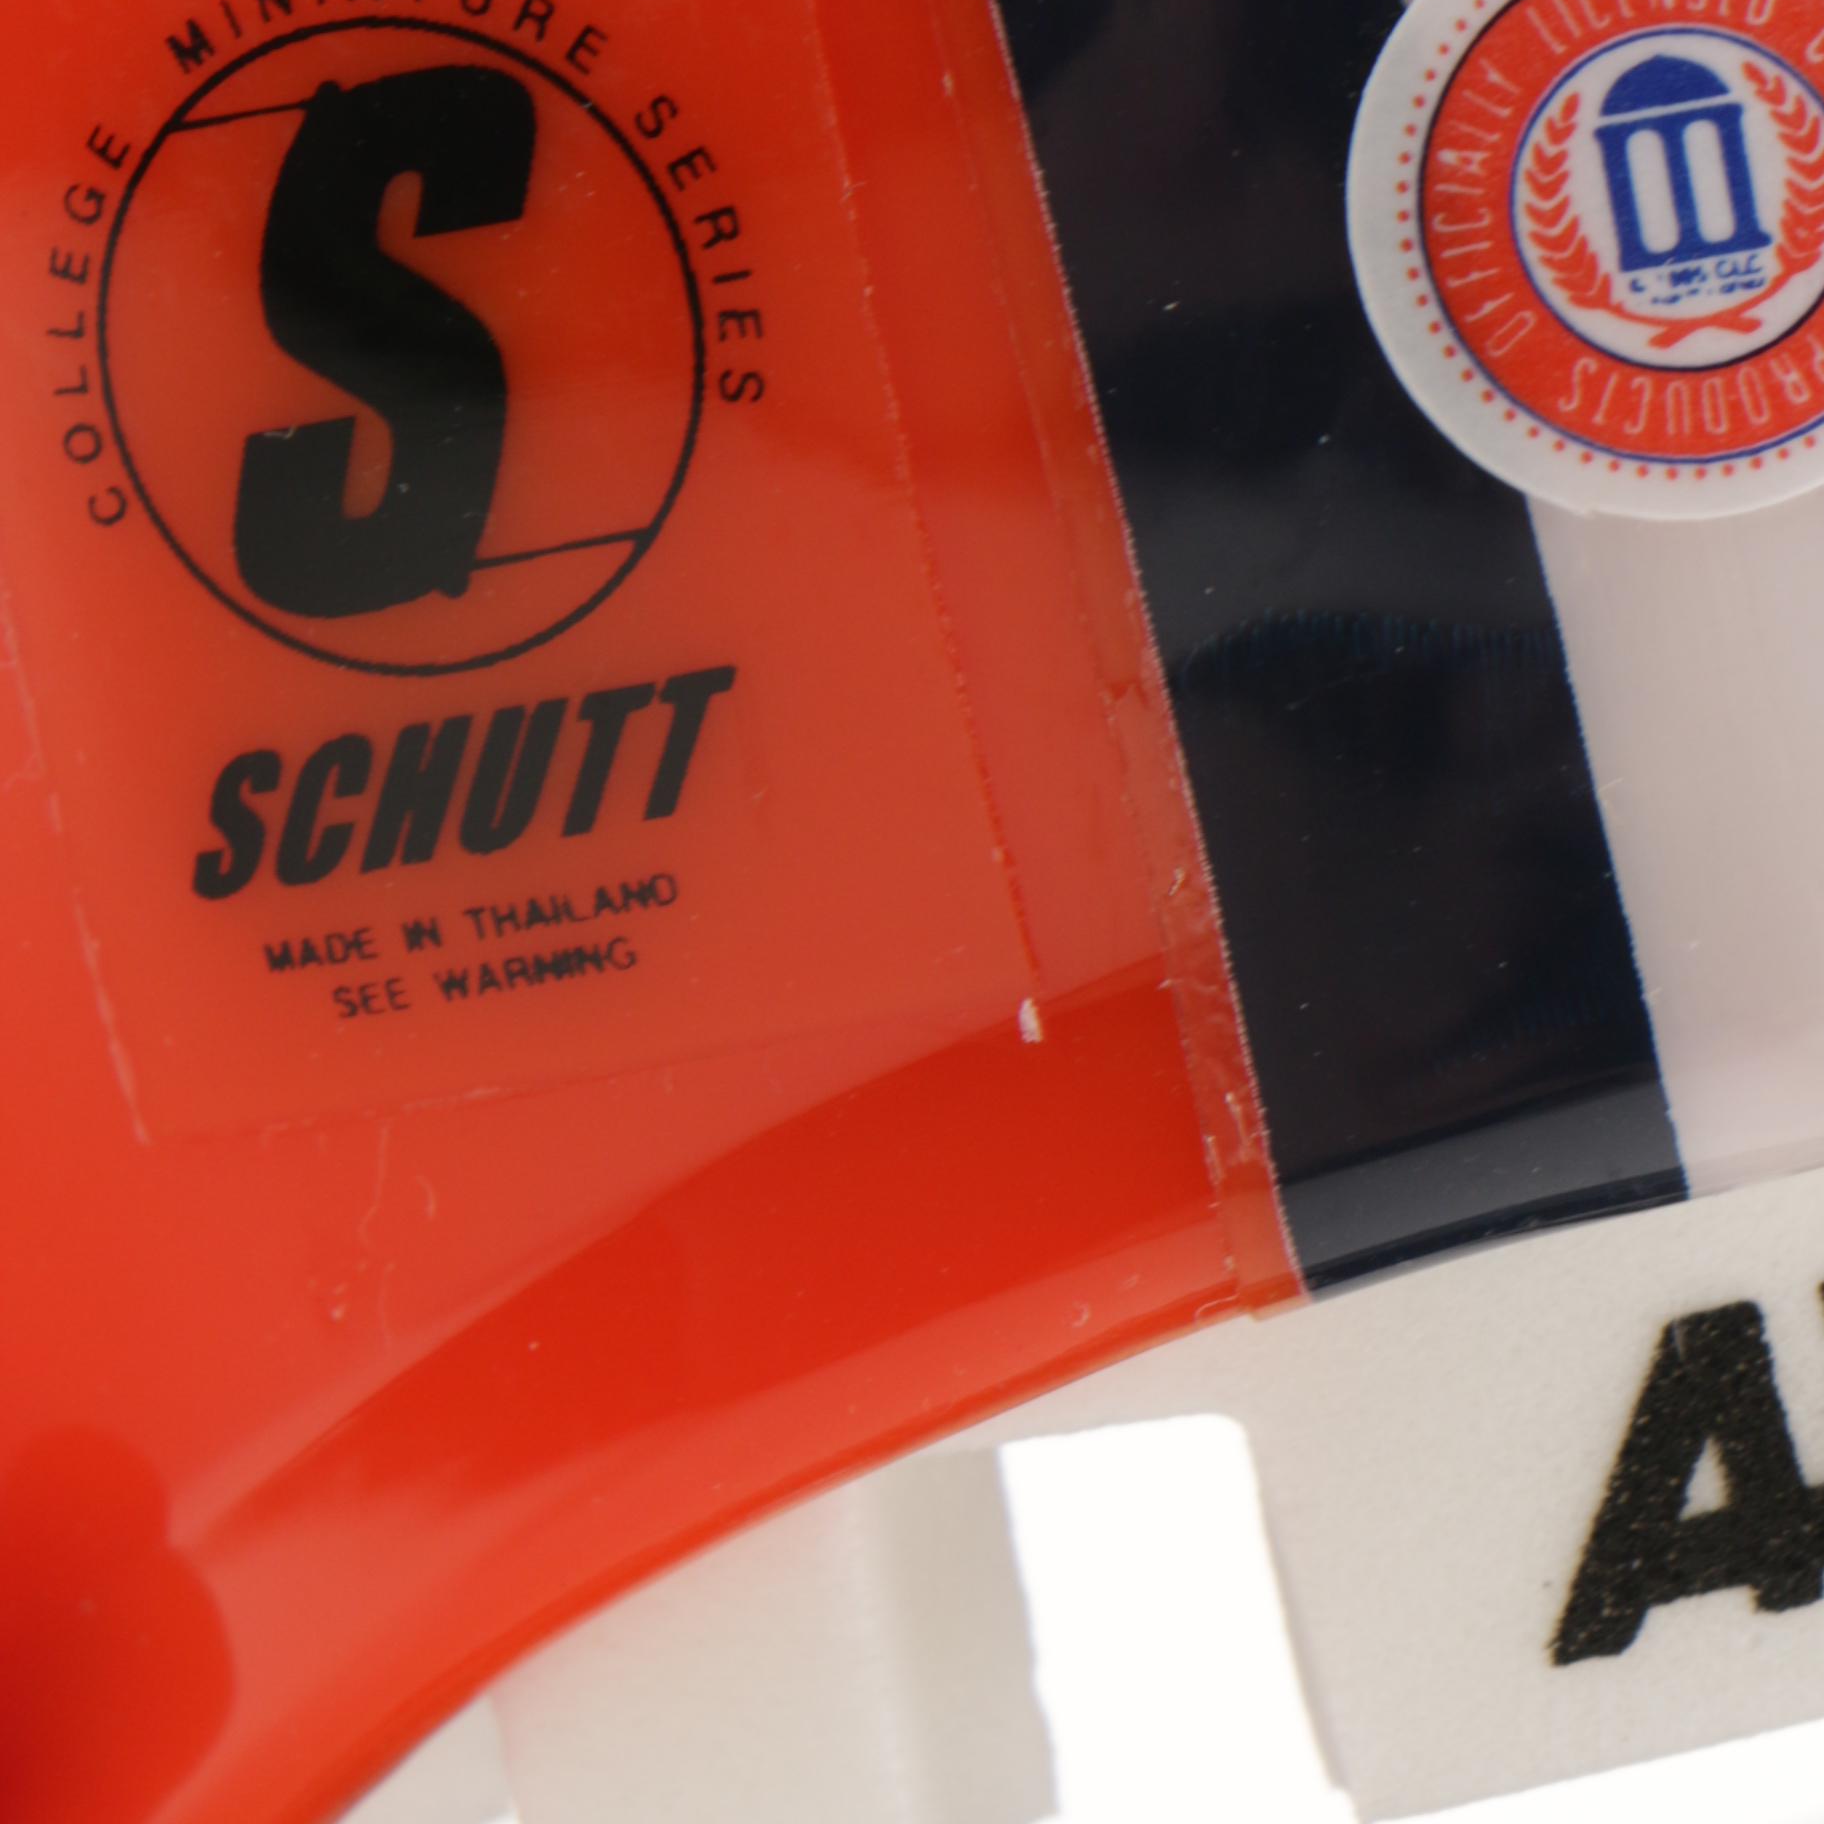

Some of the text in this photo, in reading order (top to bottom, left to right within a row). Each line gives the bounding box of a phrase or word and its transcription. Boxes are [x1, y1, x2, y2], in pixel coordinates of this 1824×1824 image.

[47, 124, 131, 528] COLLEGE
[632, 92, 765, 407] SERIES
[232, 62, 539, 621] S
[1431, 56, 1537, 358] OFFICIALLY
[193, 665, 736, 901] SCHUTT
[263, 872, 679, 973] MADE IN THAILAND
[332, 936, 639, 1019] SEE WARNING
